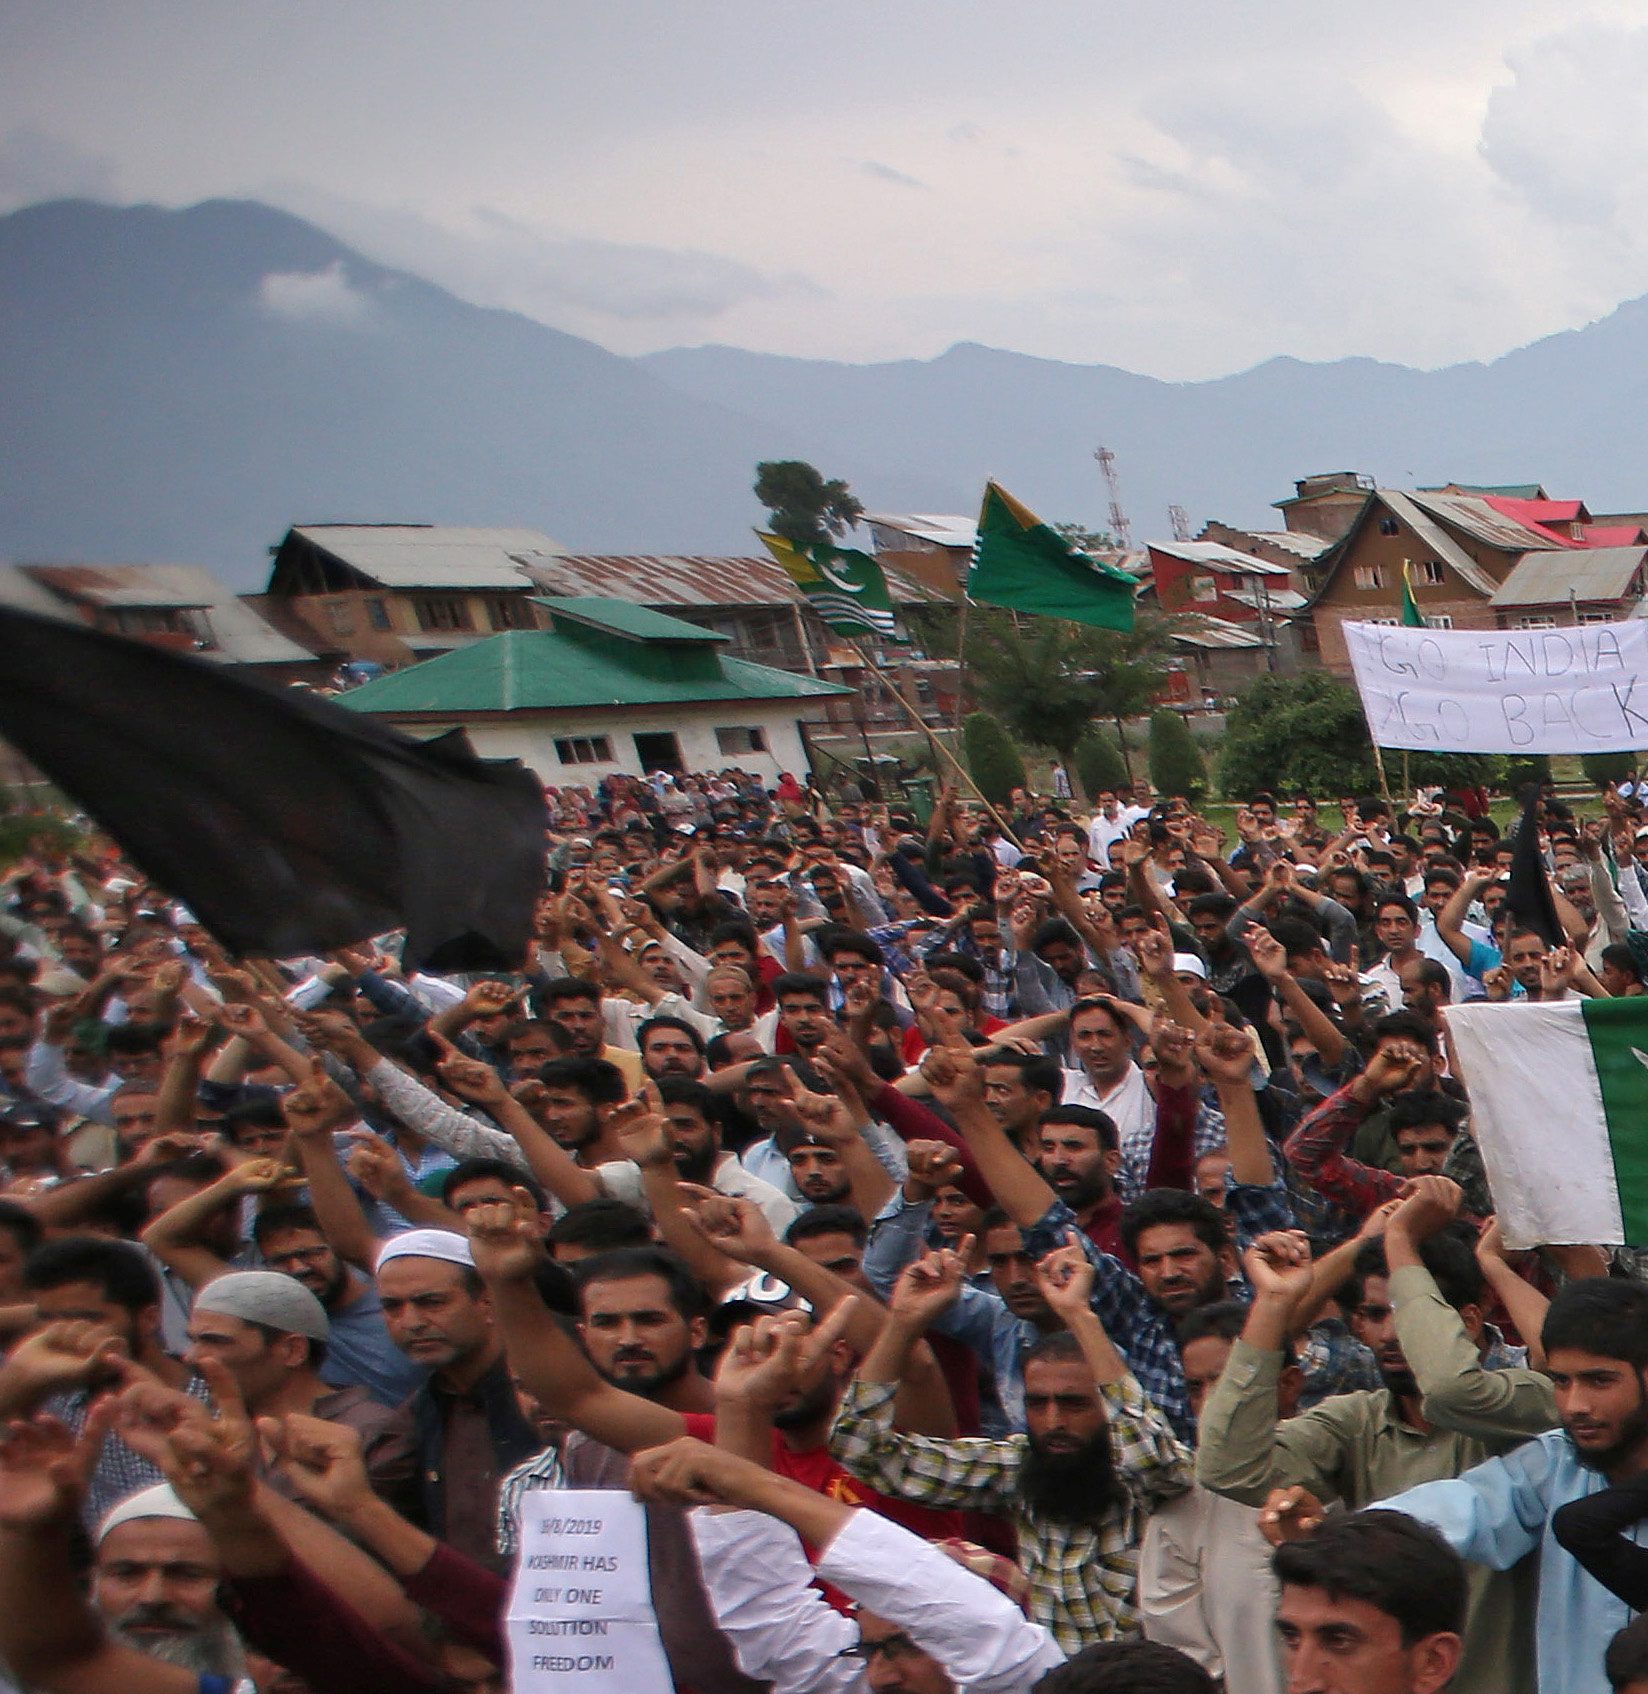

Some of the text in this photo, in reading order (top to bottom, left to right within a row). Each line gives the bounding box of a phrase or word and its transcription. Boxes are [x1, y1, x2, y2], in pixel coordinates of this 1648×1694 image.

[1479, 629, 1625, 683] INDIA
[583, 1556, 619, 1572] HAS
[566, 1589, 603, 1604] ONE
[528, 1620, 608, 1636] SOLUTION
[532, 1655, 615, 1672] FREEDOM
